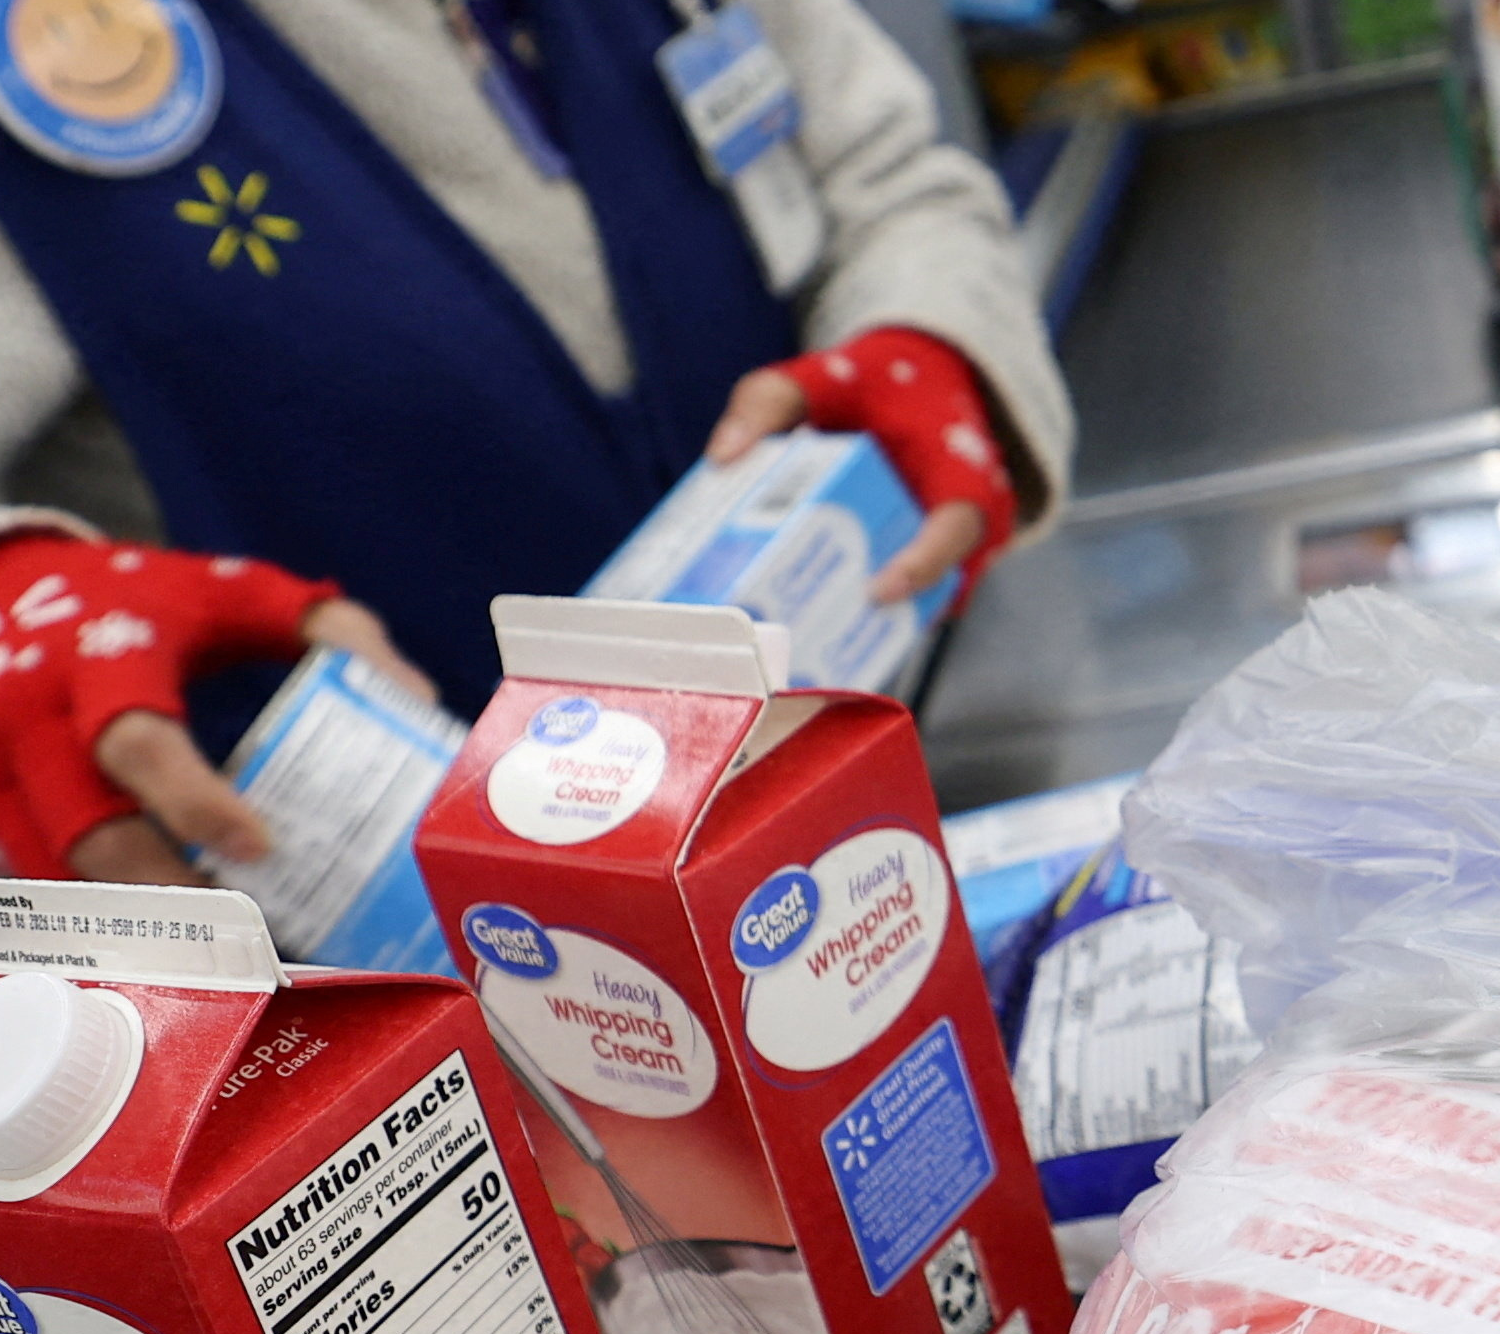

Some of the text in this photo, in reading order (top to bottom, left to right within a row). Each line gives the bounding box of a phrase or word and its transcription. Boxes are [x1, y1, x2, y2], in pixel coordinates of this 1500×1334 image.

[547, 757, 635, 786] Whipping
[555, 782, 620, 805] Cream
[848, 849, 905, 906] Heavy
[19, 896, 33, 910] By
[741, 881, 805, 945] Great
[472, 917, 542, 952] Great
[760, 908, 809, 952] Value
[806, 881, 913, 979] Whipping
[846, 914, 922, 986] Cream
[19, 951, 53, 966] Packaged
[56, 955, 64, 964] at
[66, 955, 84, 966] Plant
[86, 955, 98, 967] No.
[493, 944, 544, 967] Value
[593, 971, 661, 1018] Heavy
[544, 995, 673, 1047] Whipping
[212, 1027, 308, 1110] ure-Pak
[276, 1038, 328, 1077] Classic
[590, 1034, 683, 1074] Cream
[236, 1069, 465, 1271] Nutrition Facts
[255, 1119, 452, 1298] about 63 servings per container
[263, 1118, 481, 1317] Serving size 1 Tbsp. (15mL)
[462, 1171, 501, 1221] 50
[462, 1242, 485, 1265] Daily
[506, 1255, 530, 1278] 15%
[322, 1302, 338, 1323] per
[340, 1269, 376, 1305] serving
[535, 1315, 554, 1334] 0%
